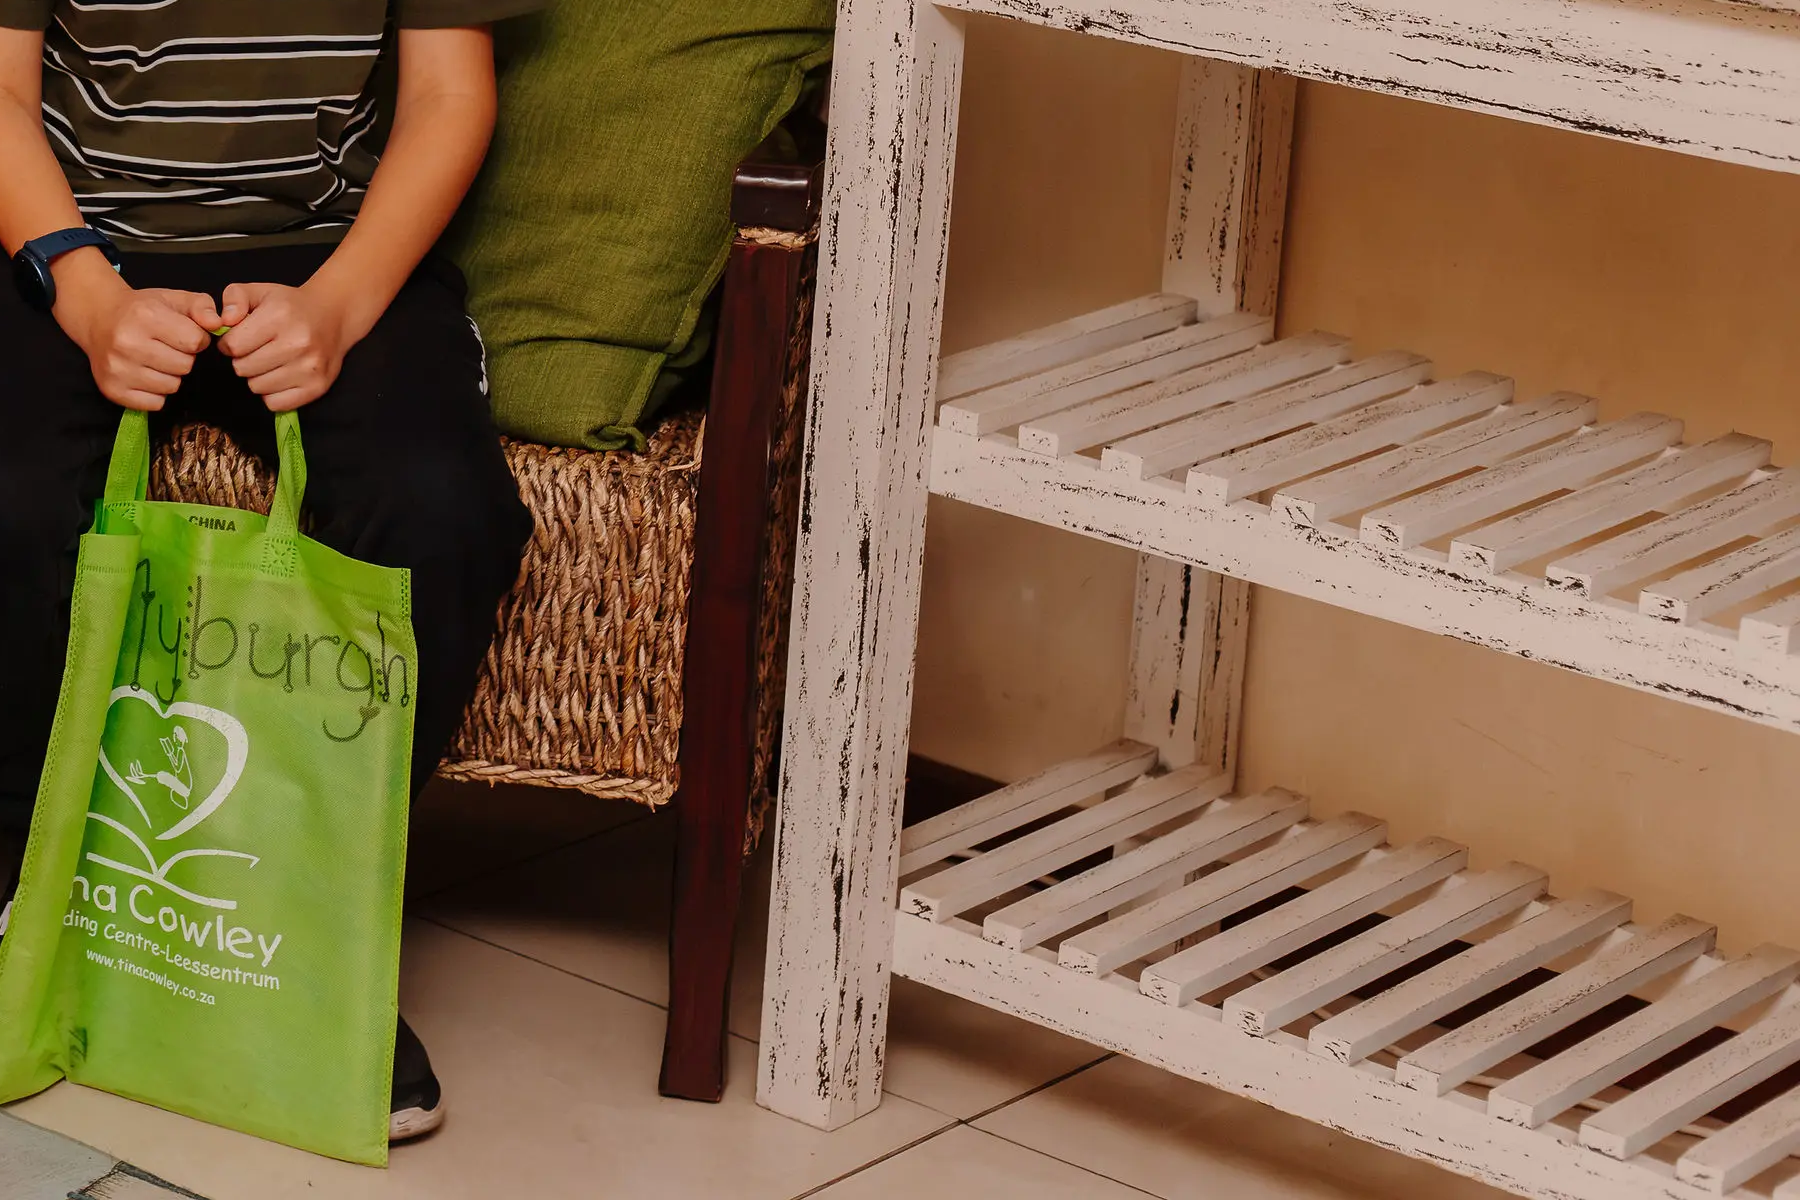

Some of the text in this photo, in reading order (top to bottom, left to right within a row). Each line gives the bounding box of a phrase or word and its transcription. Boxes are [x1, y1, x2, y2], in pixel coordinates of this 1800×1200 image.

[188, 515, 237, 532] CHINA
[63, 908, 98, 937] ding
[103, 922, 281, 991] Centre-Leessentrum
[70, 875, 282, 968] na Cowley
[85, 948, 216, 1006] www.tinacowley.co.za
